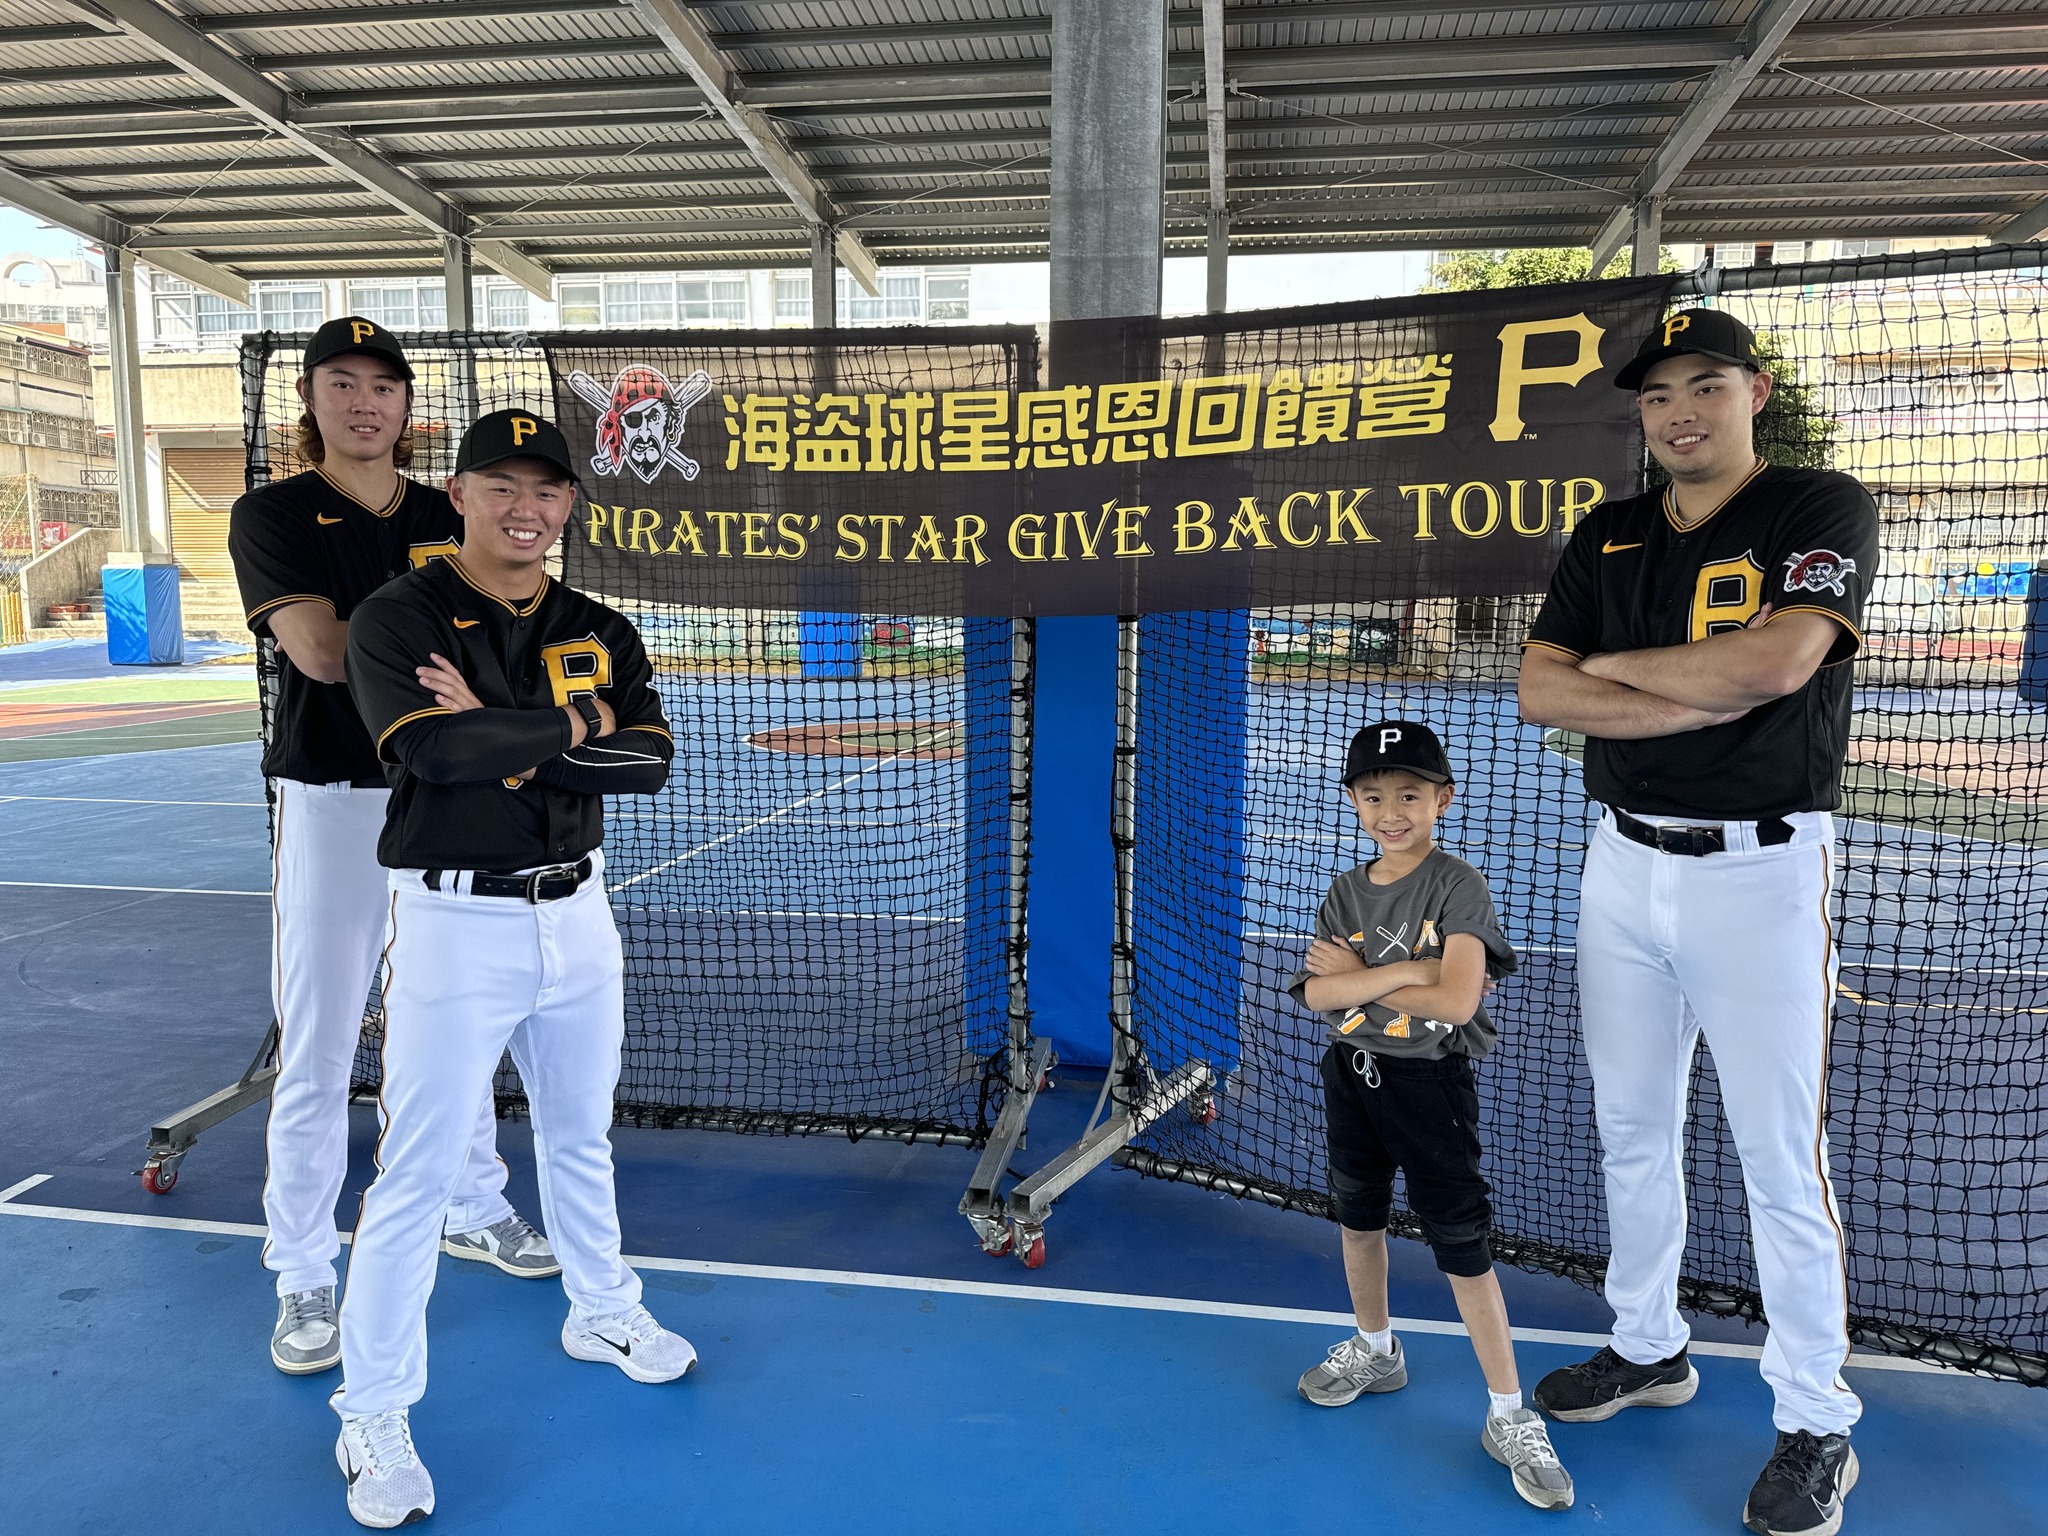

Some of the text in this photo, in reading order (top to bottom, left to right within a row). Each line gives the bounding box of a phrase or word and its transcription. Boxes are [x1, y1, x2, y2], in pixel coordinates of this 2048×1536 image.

[349, 321, 375, 344] P
[1663, 314, 1691, 347] P
[1488, 312, 1606, 442] P
[722, 353, 1453, 473] 海盜球星感恩回饋營
[510, 416, 538, 446] P
[1523, 433, 1538, 441] TM
[834, 514, 991, 568] STAR
[1008, 498, 1157, 563] GIVE
[1173, 487, 1382, 556] BACK
[1400, 477, 1607, 541] TOUR
[1378, 728, 1402, 754] P
